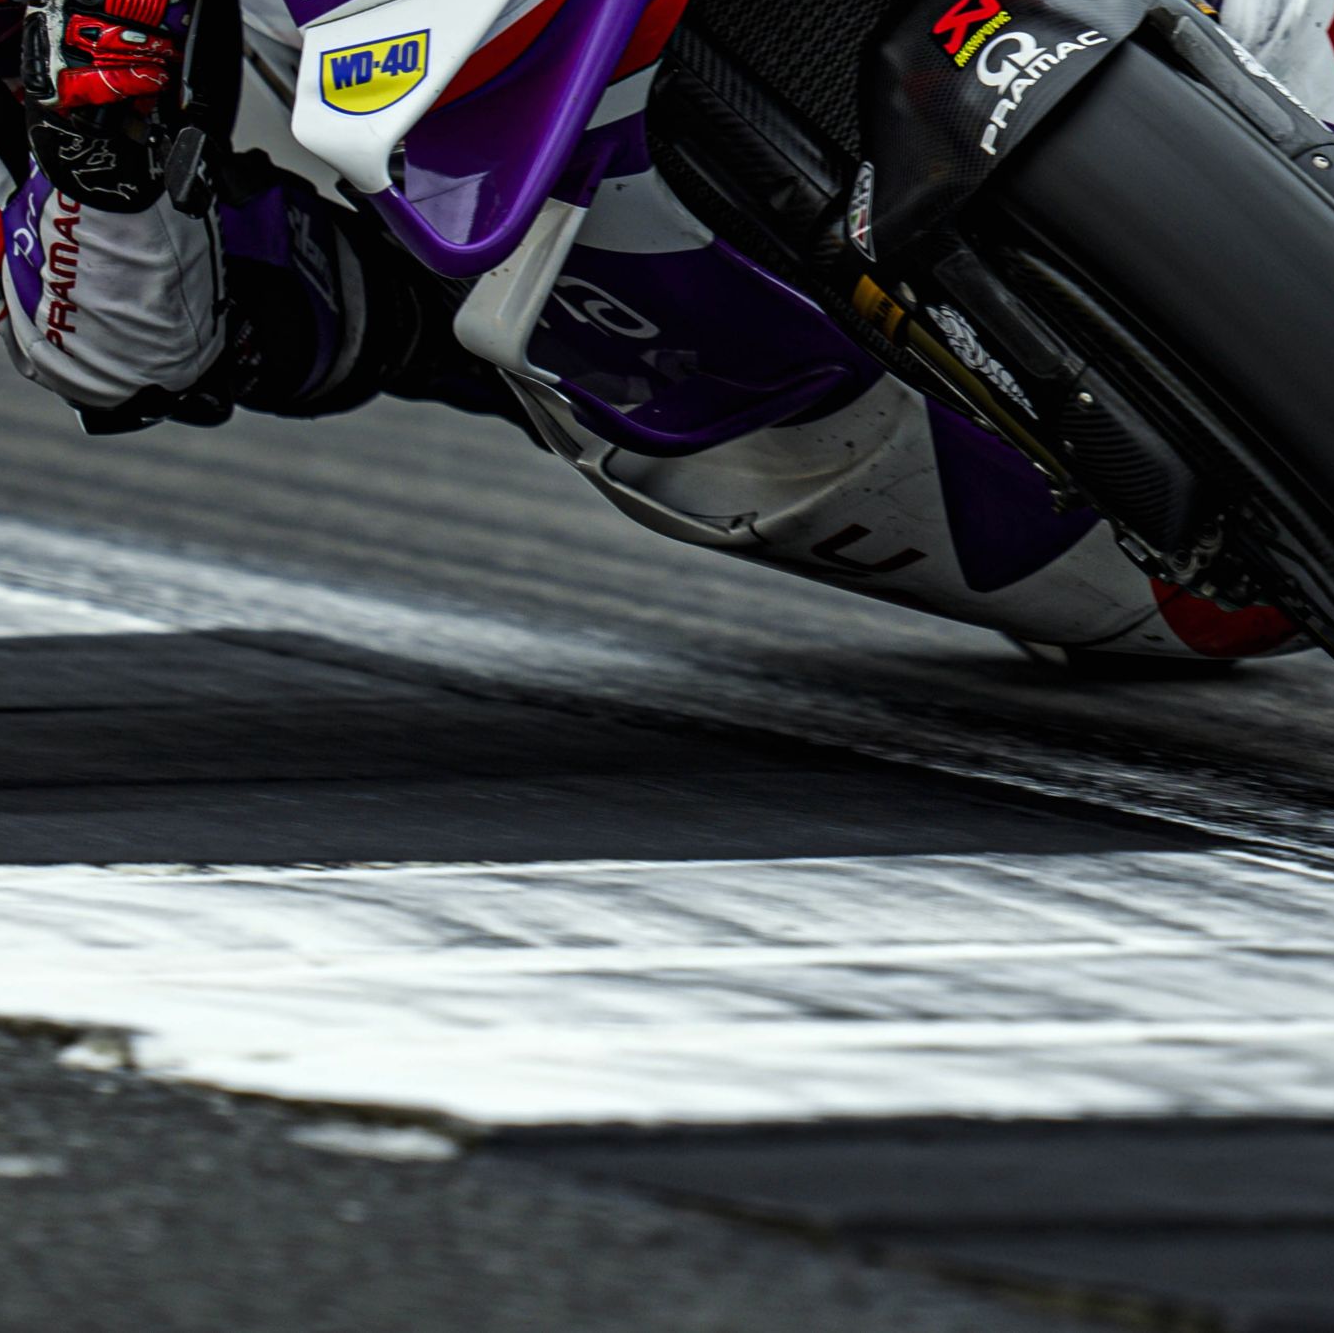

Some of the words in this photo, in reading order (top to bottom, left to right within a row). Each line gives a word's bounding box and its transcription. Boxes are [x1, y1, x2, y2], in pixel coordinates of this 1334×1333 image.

[330, 40, 419, 91] WD-40
[980, 30, 1109, 155] PRAMAC
[46, 190, 81, 357] PRAMAC
